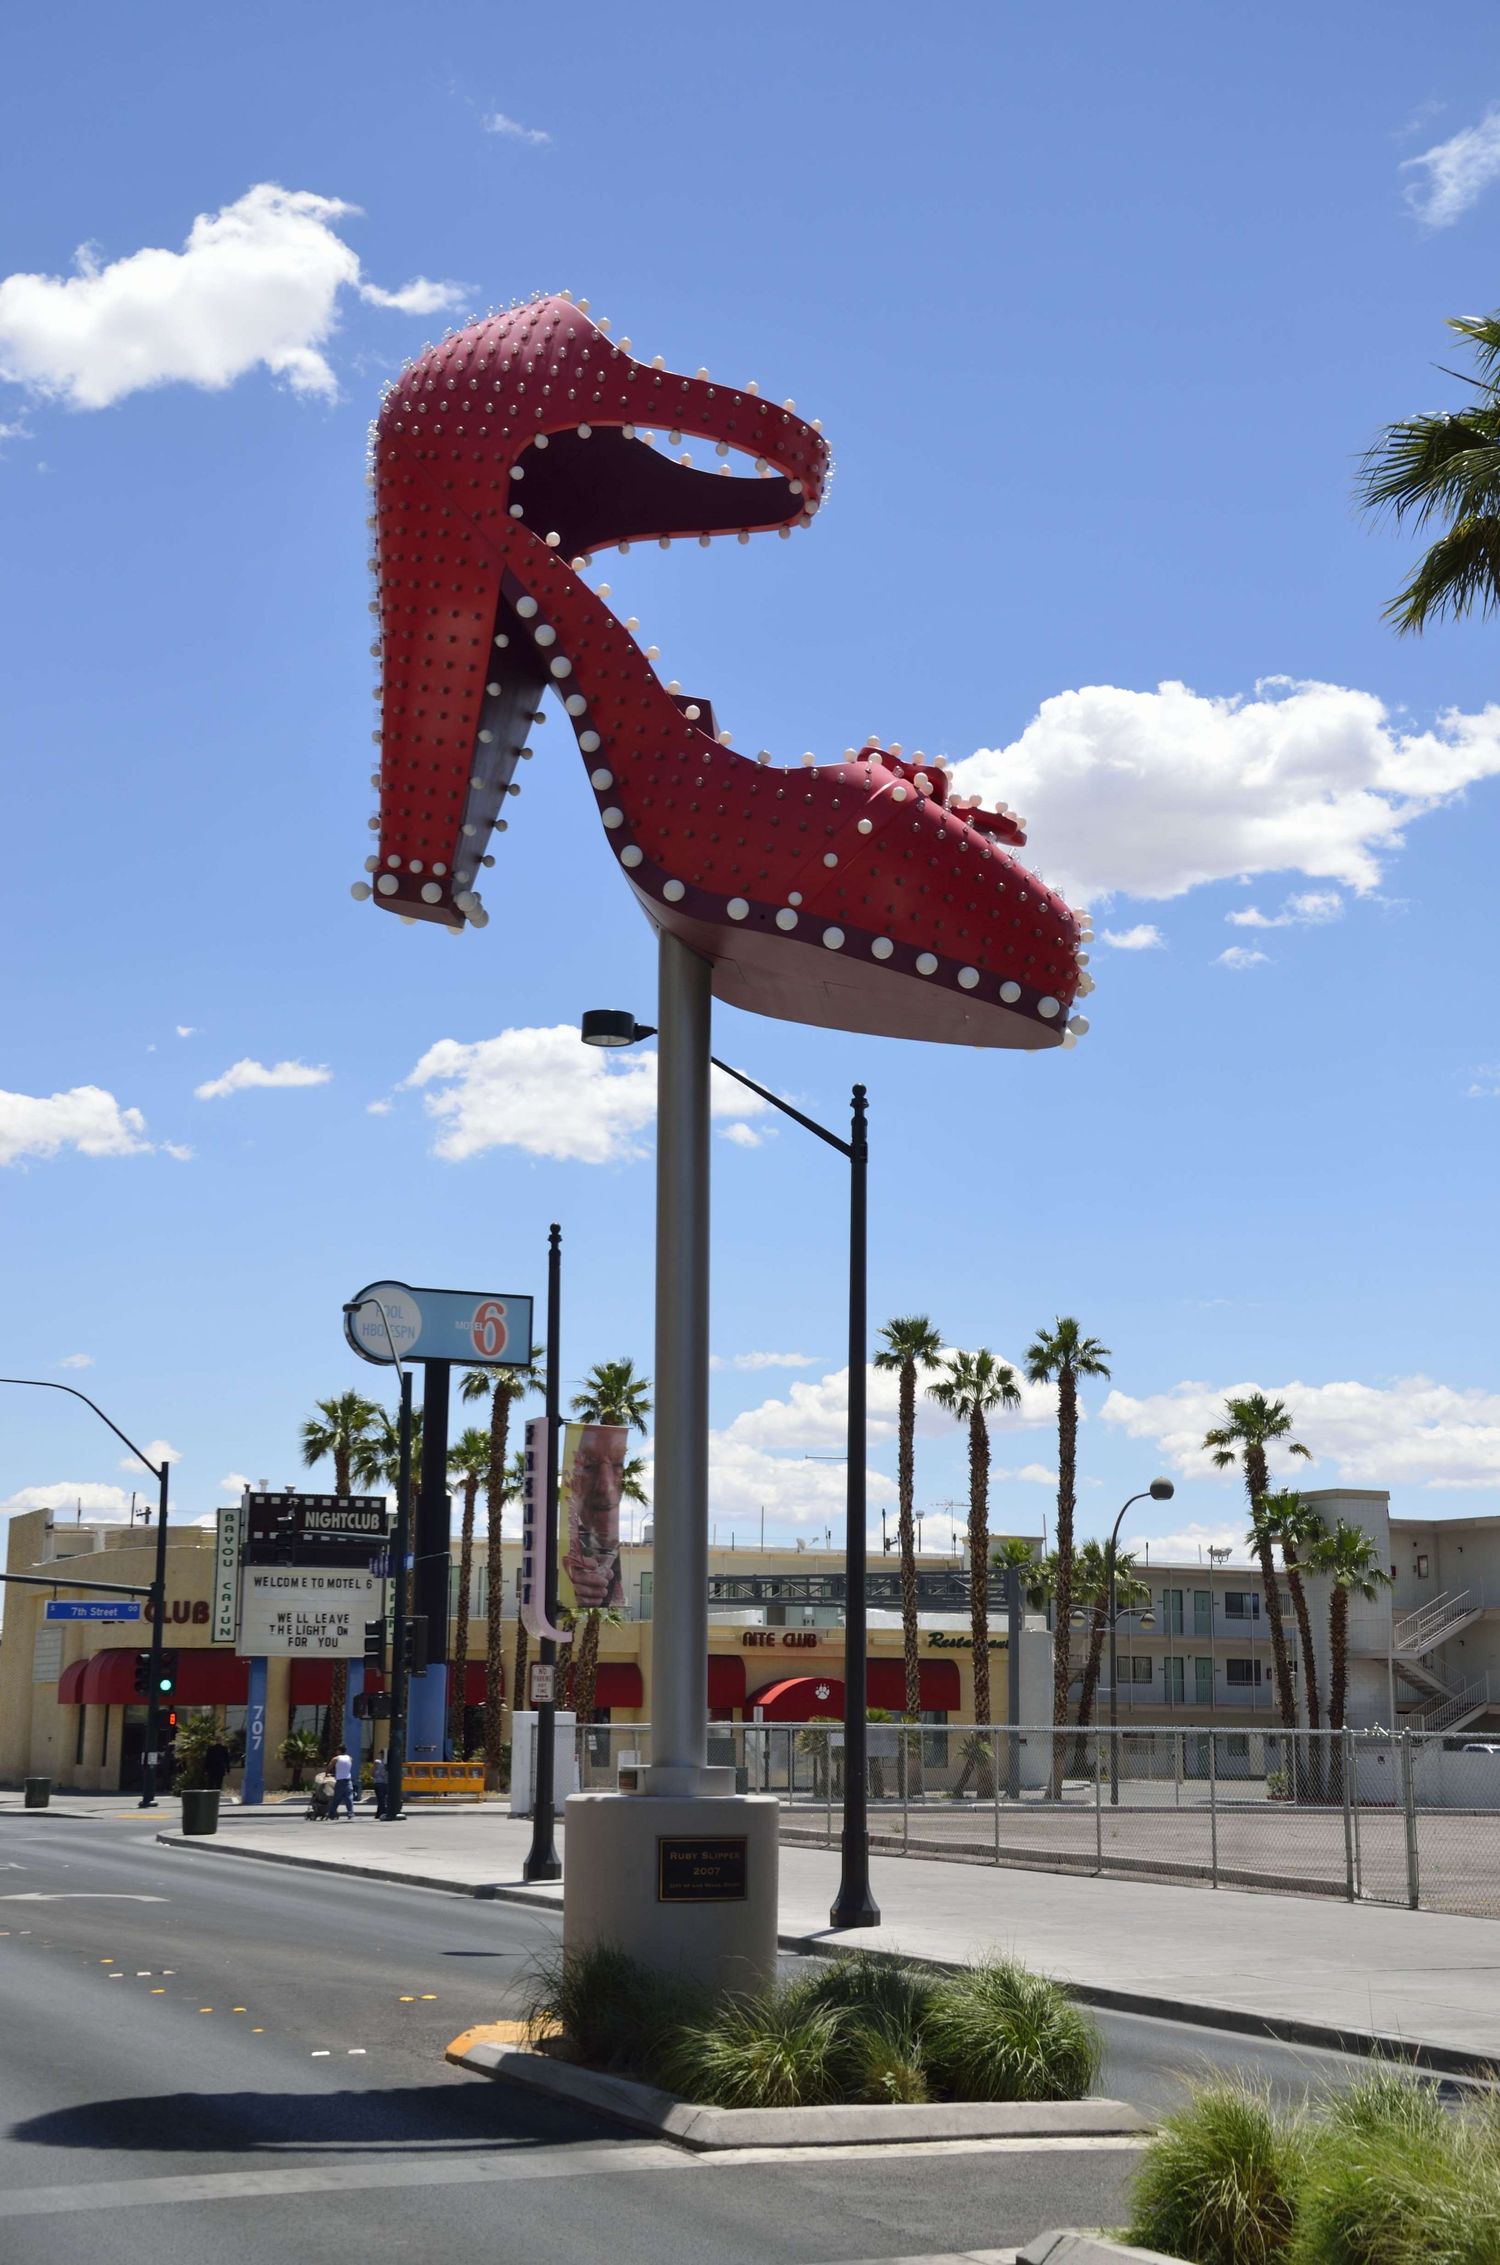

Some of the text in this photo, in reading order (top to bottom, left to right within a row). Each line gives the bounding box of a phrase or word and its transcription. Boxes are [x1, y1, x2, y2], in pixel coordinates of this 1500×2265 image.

[455, 1300, 507, 1357] MOTEL 6
[305, 1511, 380, 1530] NIGHTCLUB
[220, 1513, 235, 1636] BAYOU CAJUN
[254, 1576, 373, 1589] WELCOME TO MOTEL 6
[71, 1607, 118, 1616] 7th Street
[144, 1600, 210, 1625] CLUB
[315, 1613, 350, 1624] LEAVE
[269, 1624, 292, 1635] THE
[296, 1625, 327, 1636] LIGHT
[288, 1637, 338, 1648] FOR YOU
[782, 1632, 817, 1648] CLUB
[251, 1705, 263, 1750] 707
[692, 1866, 720, 1876] 2007
